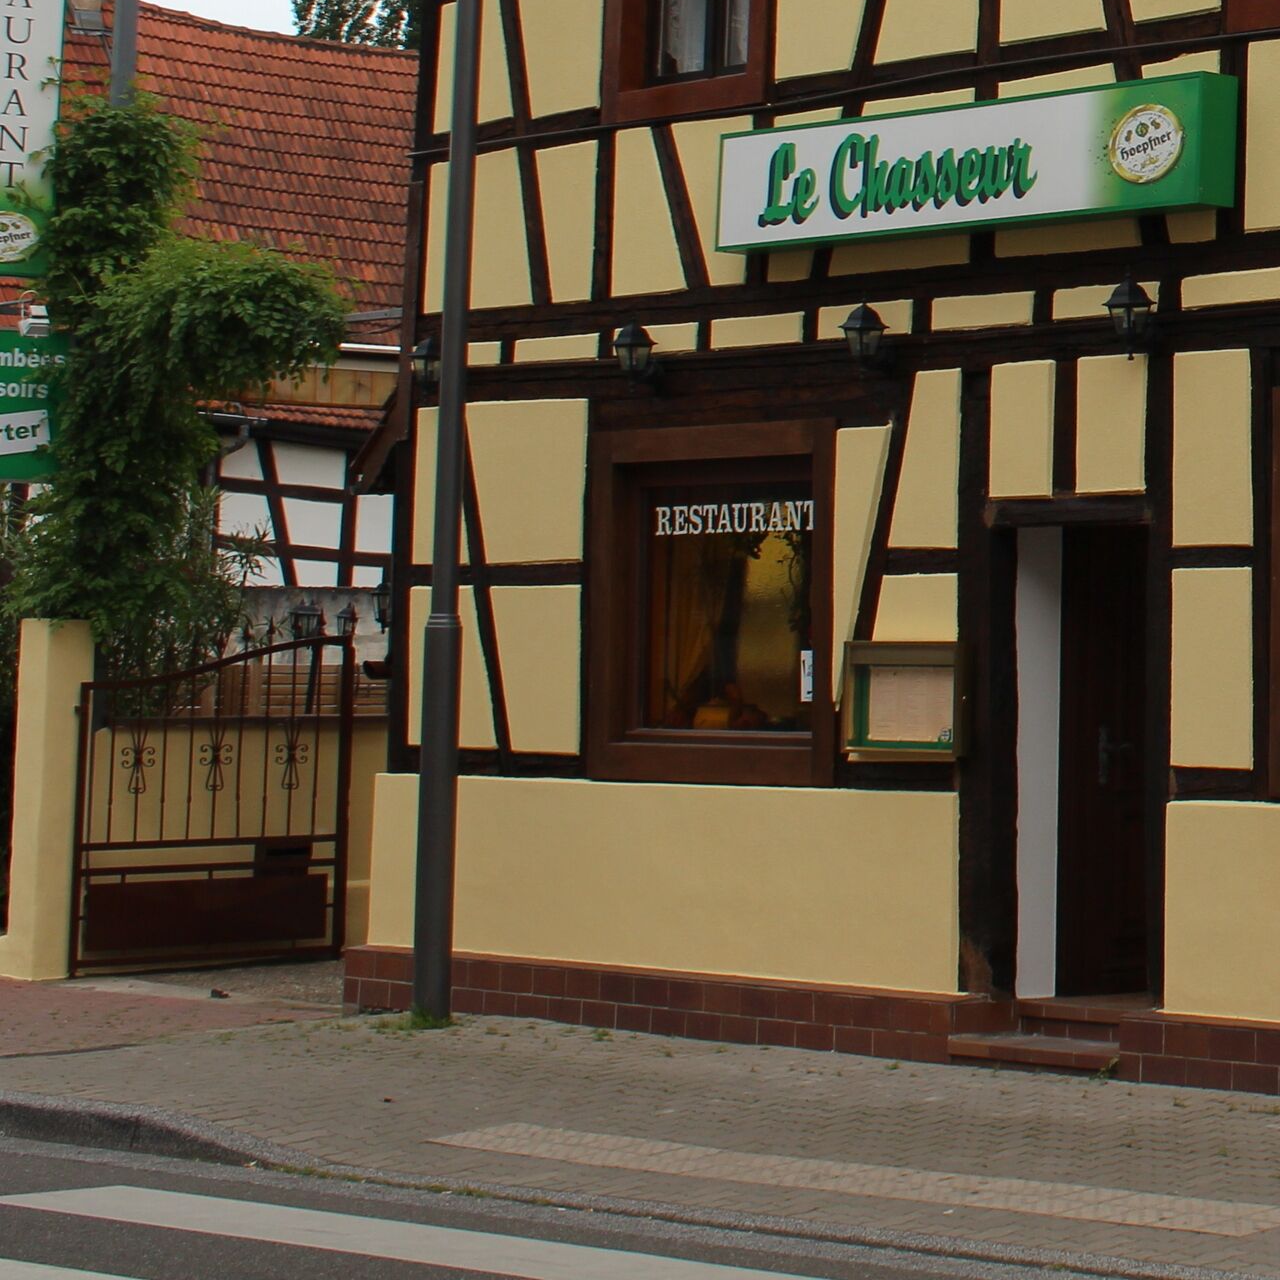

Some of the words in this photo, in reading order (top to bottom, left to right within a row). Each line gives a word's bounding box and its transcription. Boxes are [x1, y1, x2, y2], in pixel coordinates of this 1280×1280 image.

[758, 142, 820, 228] Le
[829, 133, 1038, 220] Chasseur
[0, 423, 40, 440] ter
[655, 500, 814, 536] RESTAURANT
